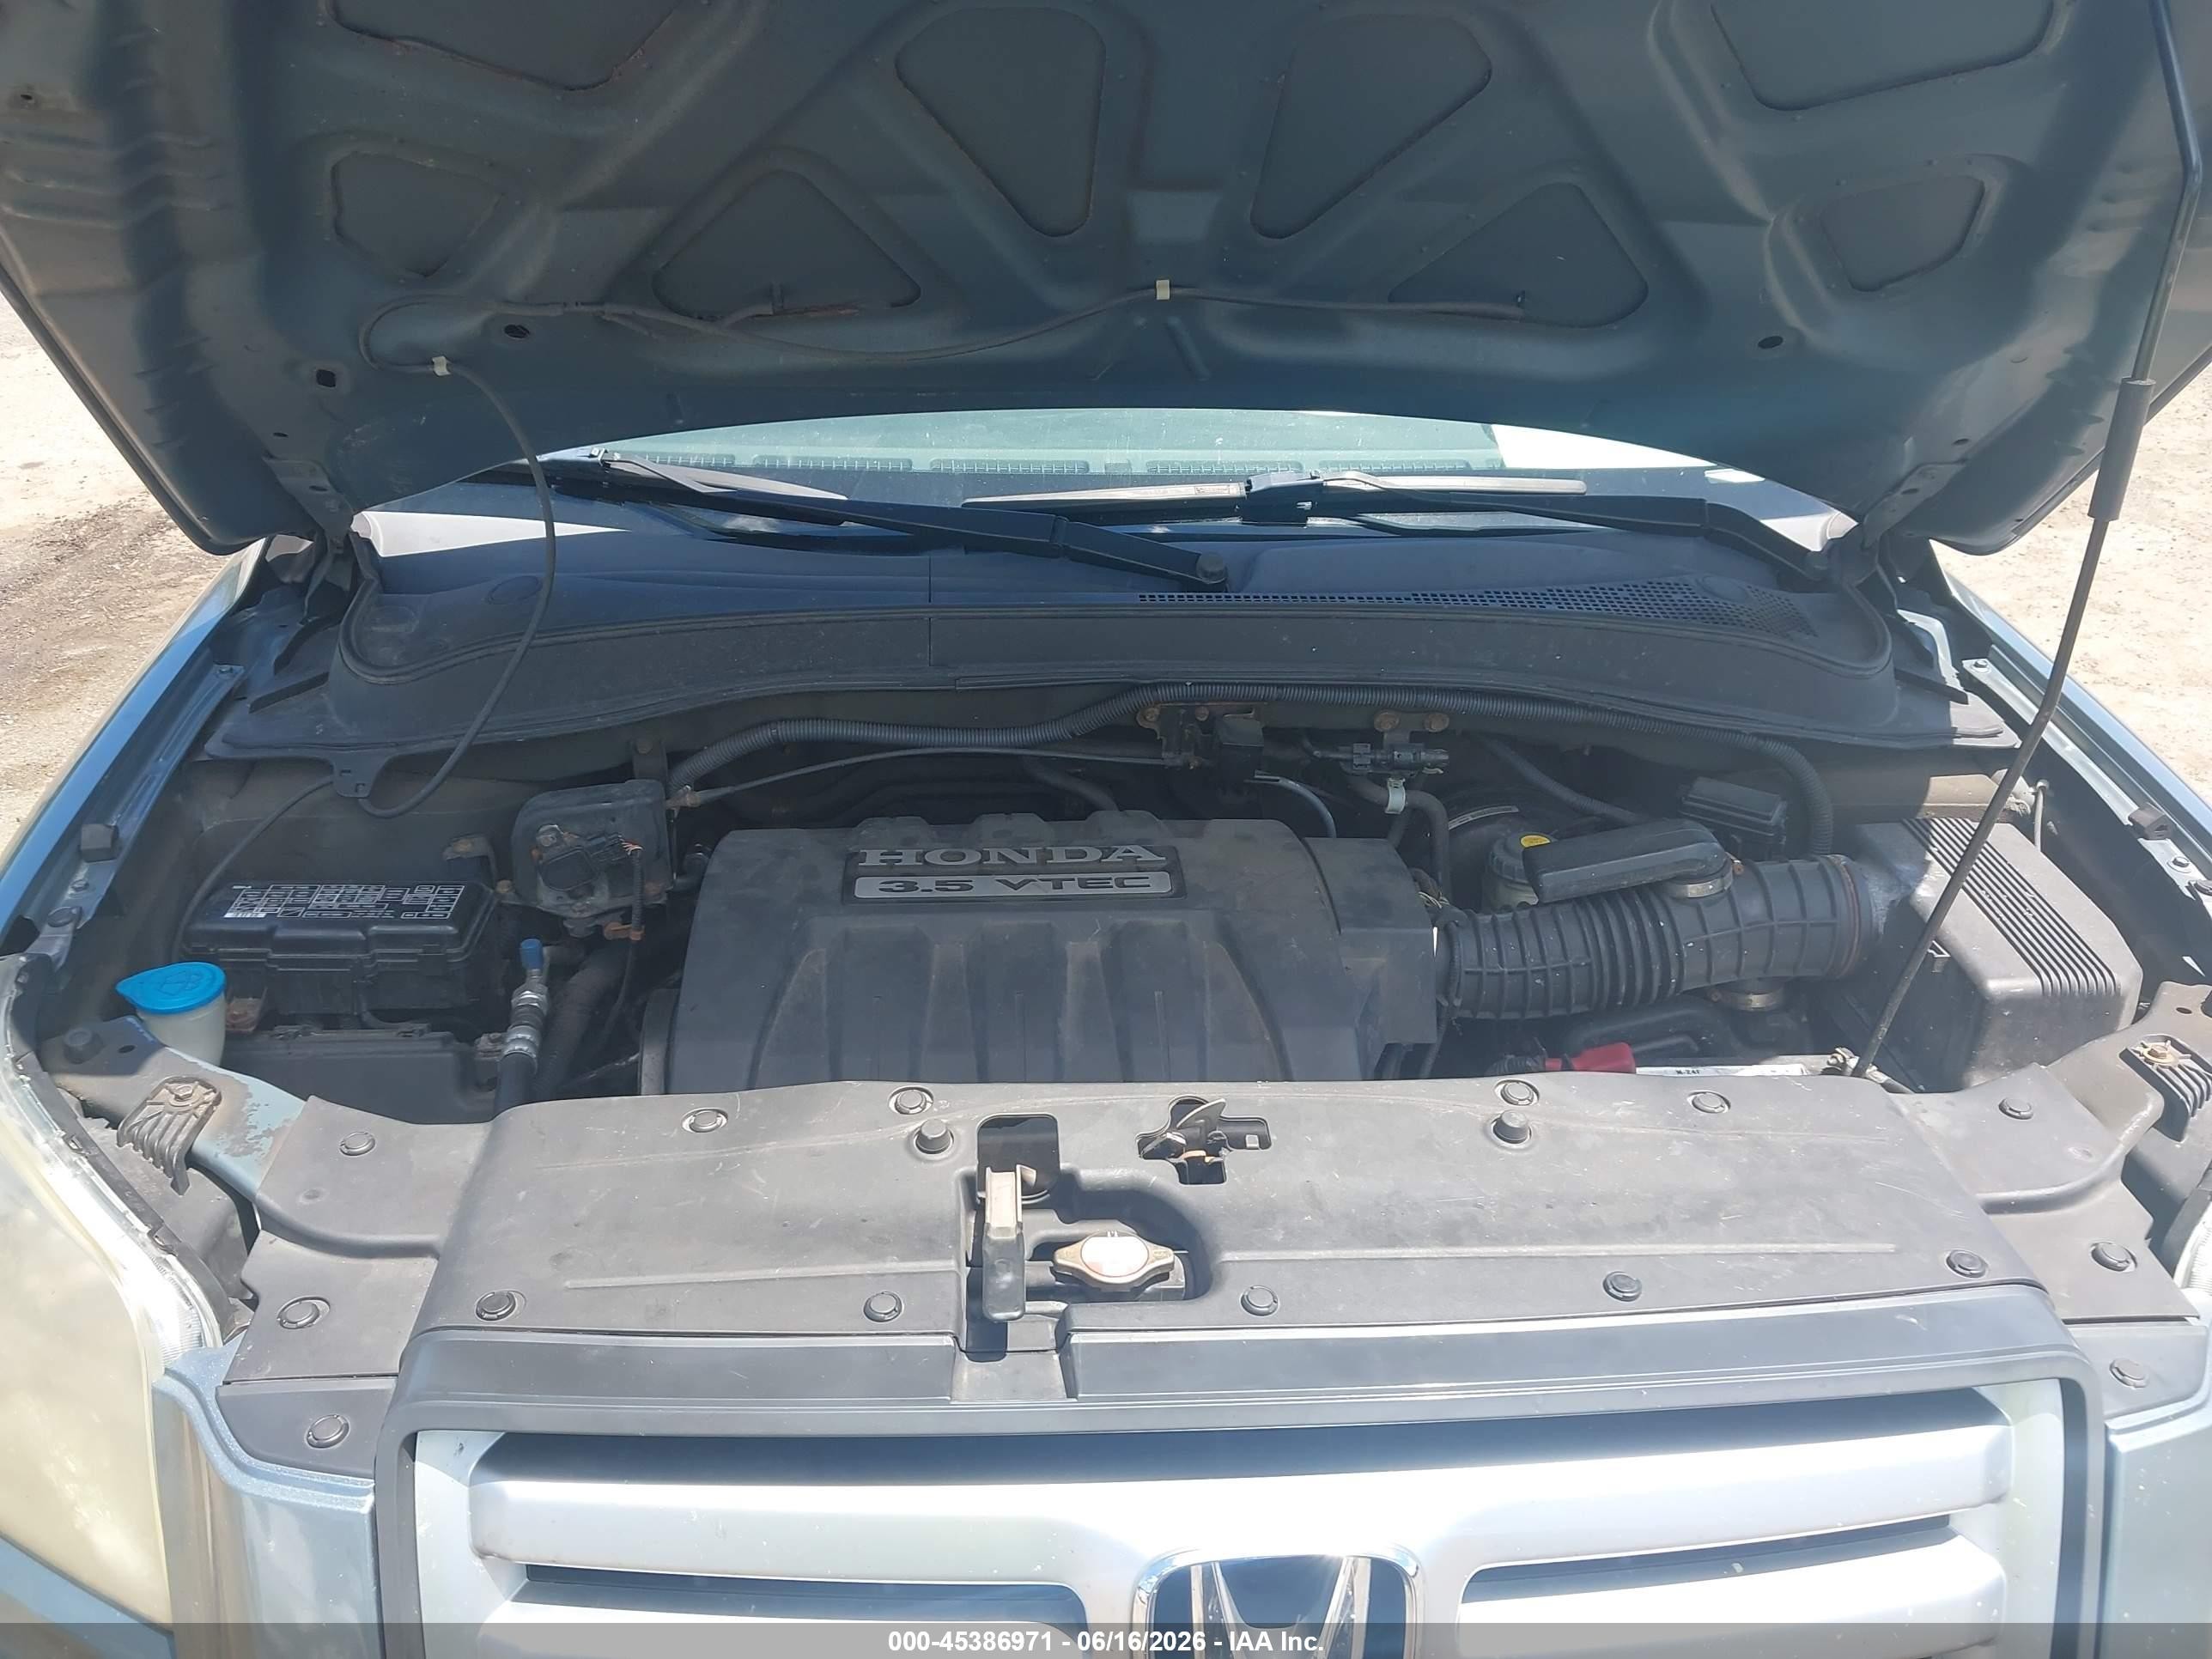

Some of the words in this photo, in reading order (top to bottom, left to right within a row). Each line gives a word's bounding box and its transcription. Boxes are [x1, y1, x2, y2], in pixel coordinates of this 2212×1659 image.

[858, 844, 1166, 866] HONDA
[878, 879, 974, 893] 3.5
[995, 877, 1151, 891] VTEC
